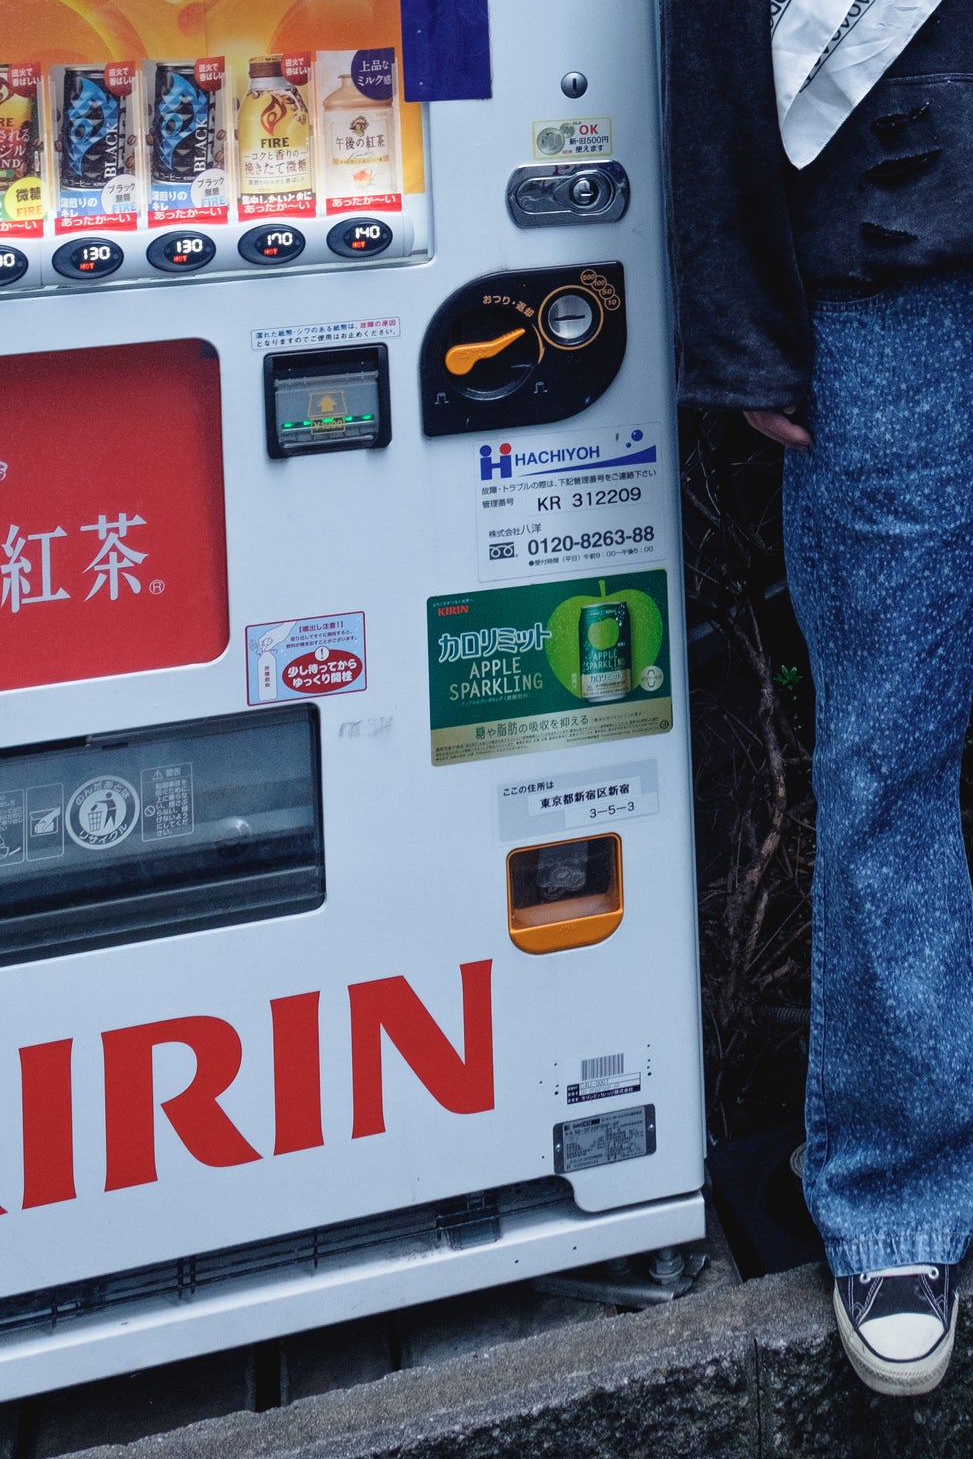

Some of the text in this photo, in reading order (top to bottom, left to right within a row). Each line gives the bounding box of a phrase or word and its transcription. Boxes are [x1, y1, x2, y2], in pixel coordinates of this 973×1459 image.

[358, 60, 389, 72] 上品な
[357, 75, 392, 87] ミルク感
[579, 124, 598, 135] OK
[194, 117, 208, 172] BLACK
[260, 137, 289, 149] FIRE
[336, 134, 386, 151] 午後の紅茶
[575, 145, 604, 153] 使えます
[104, 123, 119, 179] BLACK
[244, 160, 307, 175] 挽きたて微糖
[16, 188, 41, 202] 微糖
[16, 206, 42, 217] FIRE
[267, 232, 293, 246] 170
[355, 225, 381, 239] 140
[83, 245, 110, 260] 130
[176, 238, 203, 254] 130
[264, 247, 278, 256] HOT
[352, 240, 366, 249] HOT
[80, 262, 95, 271] HOT
[173, 254, 188, 263] HOT
[515, 445, 600, 467] HACHIYOH
[482, 486, 642, 512] 管理番号 KR 312209
[488, 523, 542, 539] 株式会社八洋
[528, 526, 655, 555] 0120-8263-88
[0, 512, 149, 614] 紅茶
[438, 604, 469, 617] KIRIN
[438, 622, 552, 663] カロリミット
[592, 649, 618, 660] APPLE
[287, 658, 358, 678] 少し待ってから
[470, 656, 522, 679] APPLE
[292, 671, 353, 688] ゆっくり開栓
[449, 672, 543, 701] SPARKLING
[475, 715, 589, 740] 糖や脂肪の吸収を抑える
[503, 781, 554, 797] ここの住所は
[540, 783, 630, 809] 東京都新宿区新宿
[79, 823, 128, 844] リサイクル
[0, 958, 495, 1216] IRIN
